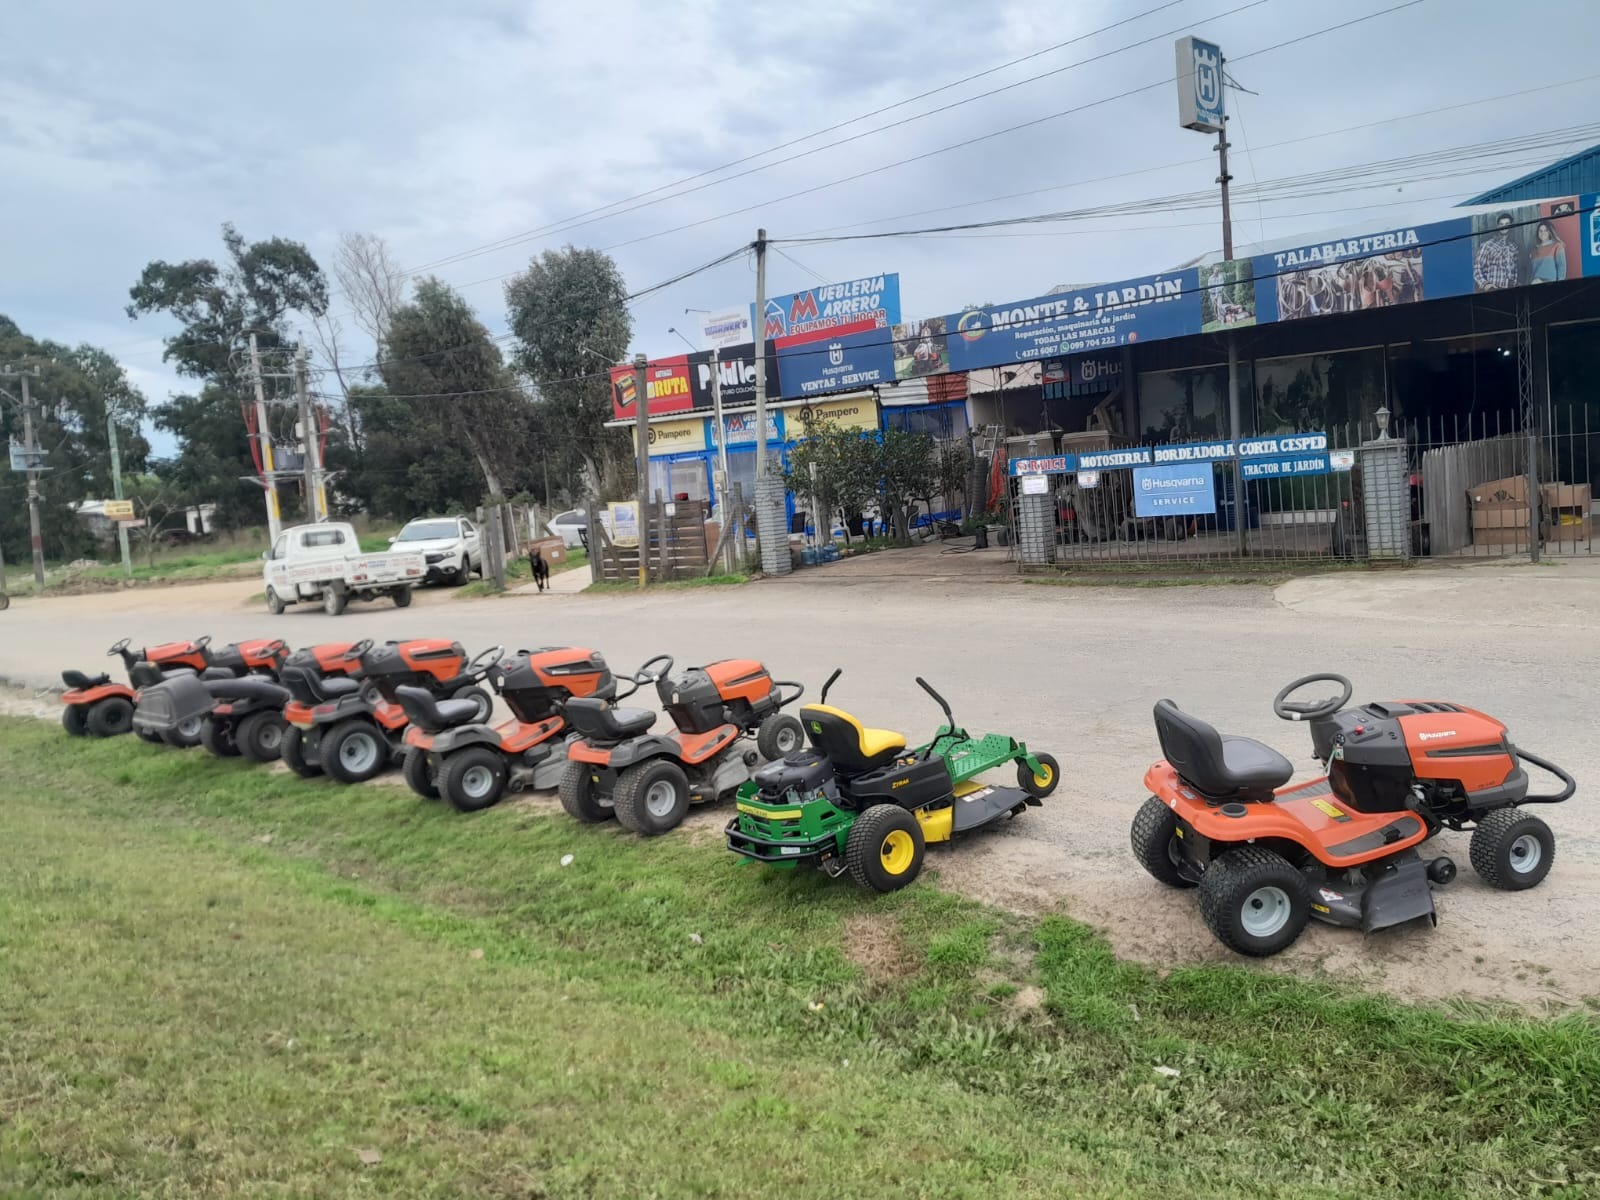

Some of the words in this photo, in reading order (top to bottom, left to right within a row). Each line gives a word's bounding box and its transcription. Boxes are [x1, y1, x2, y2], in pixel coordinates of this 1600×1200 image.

[1274, 229, 1420, 268] TALABARTERIA
[824, 294, 880, 317] ARRERO
[991, 299, 1068, 332] MONTE
[1074, 296, 1089, 317] &
[1095, 276, 1182, 318] JARDÍN
[790, 318, 837, 335] EQUIPAMOS
[840, 315, 853, 325] TU
[854, 309, 886, 321] HOGAR
[1034, 333, 1060, 345] TODAS
[1061, 331, 1077, 341] LAS
[1080, 325, 1115, 338] MARCAS
[801, 378, 835, 392] VENTAS
[842, 370, 879, 384] SERVICE
[815, 407, 859, 420] Pampero
[657, 429, 691, 440] Pampero
[1080, 451, 1150, 468] MOTOSIERRA
[1154, 444, 1236, 462] BORDEADORA
[1239, 439, 1278, 455] CORTA
[1280, 436, 1327, 451] CESPED
[1243, 462, 1279, 475] TRACTOR
[1281, 461, 1292, 473] DE
[1152, 476, 1205, 489] Husqvarna
[1153, 496, 1196, 506] SERVICE
